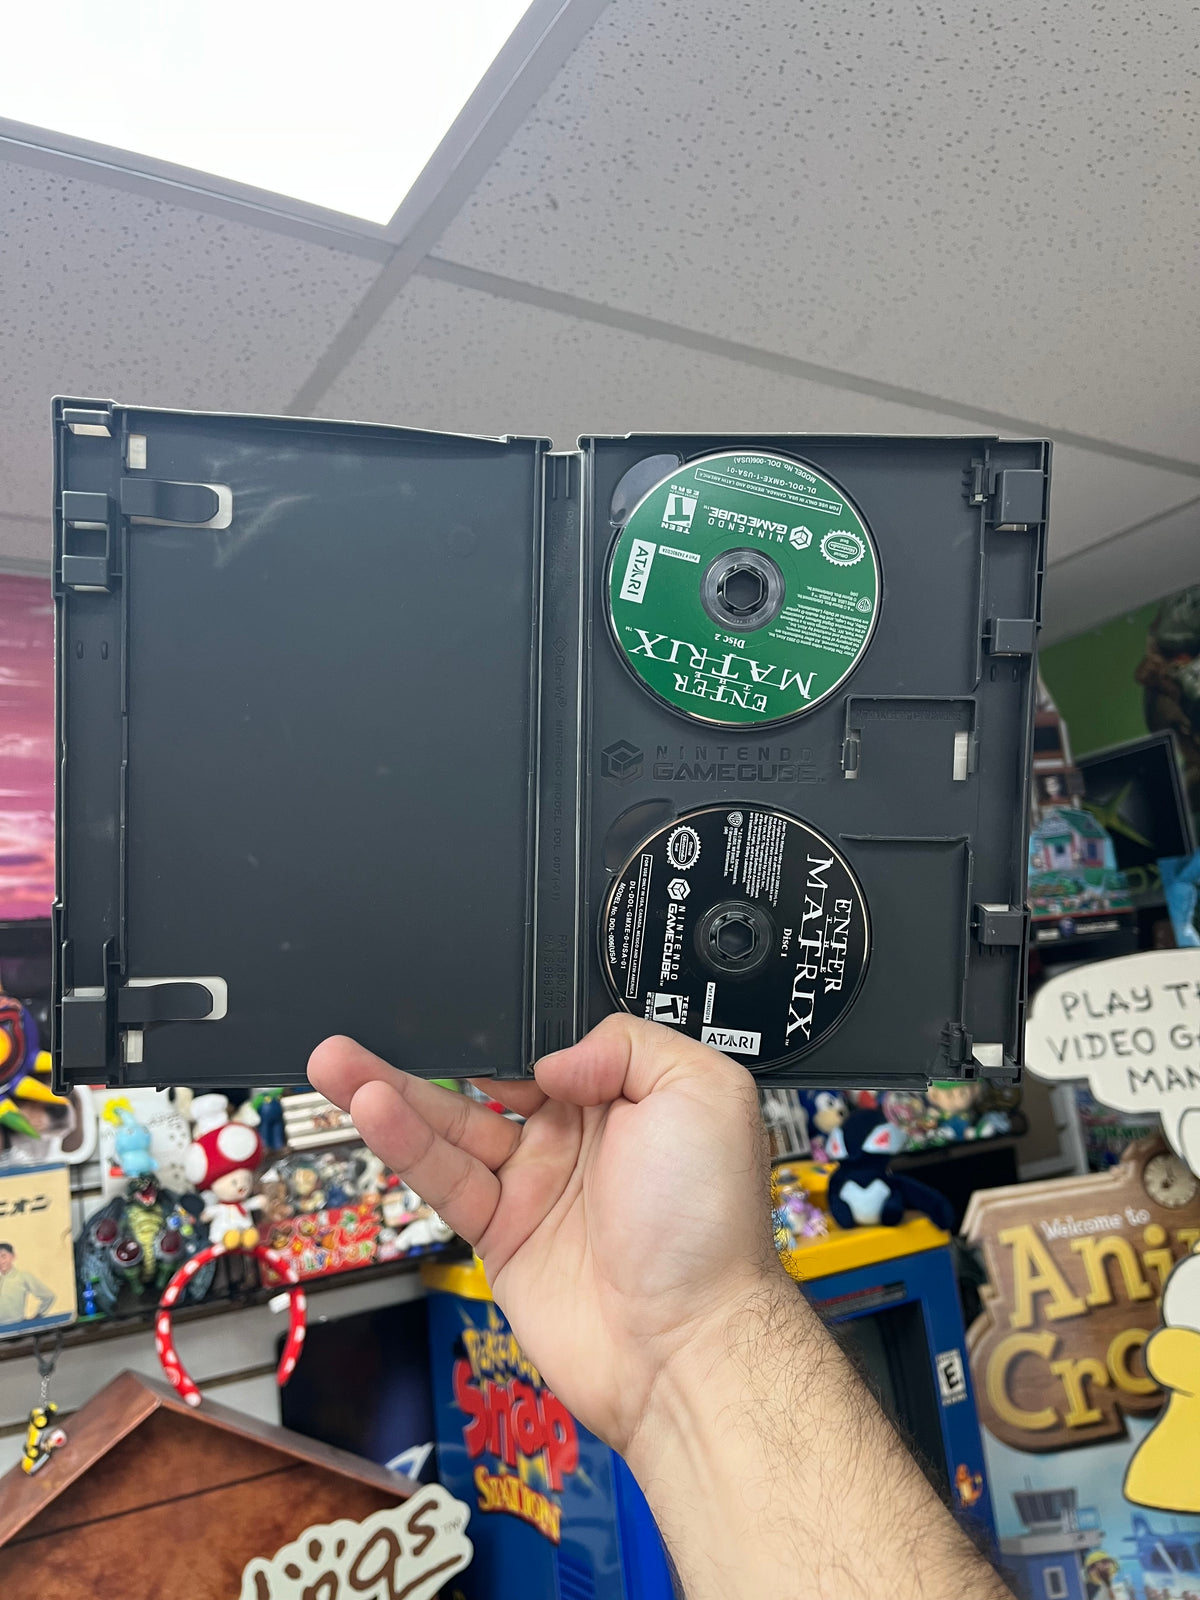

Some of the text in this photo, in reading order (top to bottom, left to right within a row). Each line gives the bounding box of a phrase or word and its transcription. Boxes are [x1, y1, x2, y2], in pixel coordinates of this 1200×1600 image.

[700, 473, 720, 481] AMERICA
[783, 464, 793, 472] No.
[795, 468, 816, 483] MODEL
[671, 485, 699, 495] ESRB
[746, 484, 764, 492] MEXICO
[668, 497, 690, 522] T
[709, 507, 787, 534] GAMECUBE
[661, 522, 690, 534] TEEN
[708, 518, 783, 542] NINTENDO
[627, 546, 648, 595] ATARI
[723, 636, 745, 648] Disc
[628, 628, 817, 699] MATRIX
[673, 673, 767, 712] ENTER
[695, 671, 752, 690] THE
[656, 745, 813, 761] NINTENDO
[652, 761, 817, 783] GAMECUBE
[613, 883, 626, 904] MODEL
[661, 903, 677, 980] GAMECUBE
[671, 906, 686, 980] NINTENDO
[782, 928, 792, 950] Disc
[786, 854, 834, 1040] MATRIX
[820, 916, 832, 972] THE
[824, 899, 852, 993] ENTER
[656, 998, 679, 1019] T
[681, 996, 689, 1024] TEEN
[1060, 980, 1200, 1022] PLAY T
[706, 1033, 753, 1049] ATARI
[1046, 1024, 1200, 1064] VIDEO G
[1040, 1206, 1151, 1241] Welcome to
[943, 1361, 960, 1390] E
[452, 1357, 580, 1494] Snap
